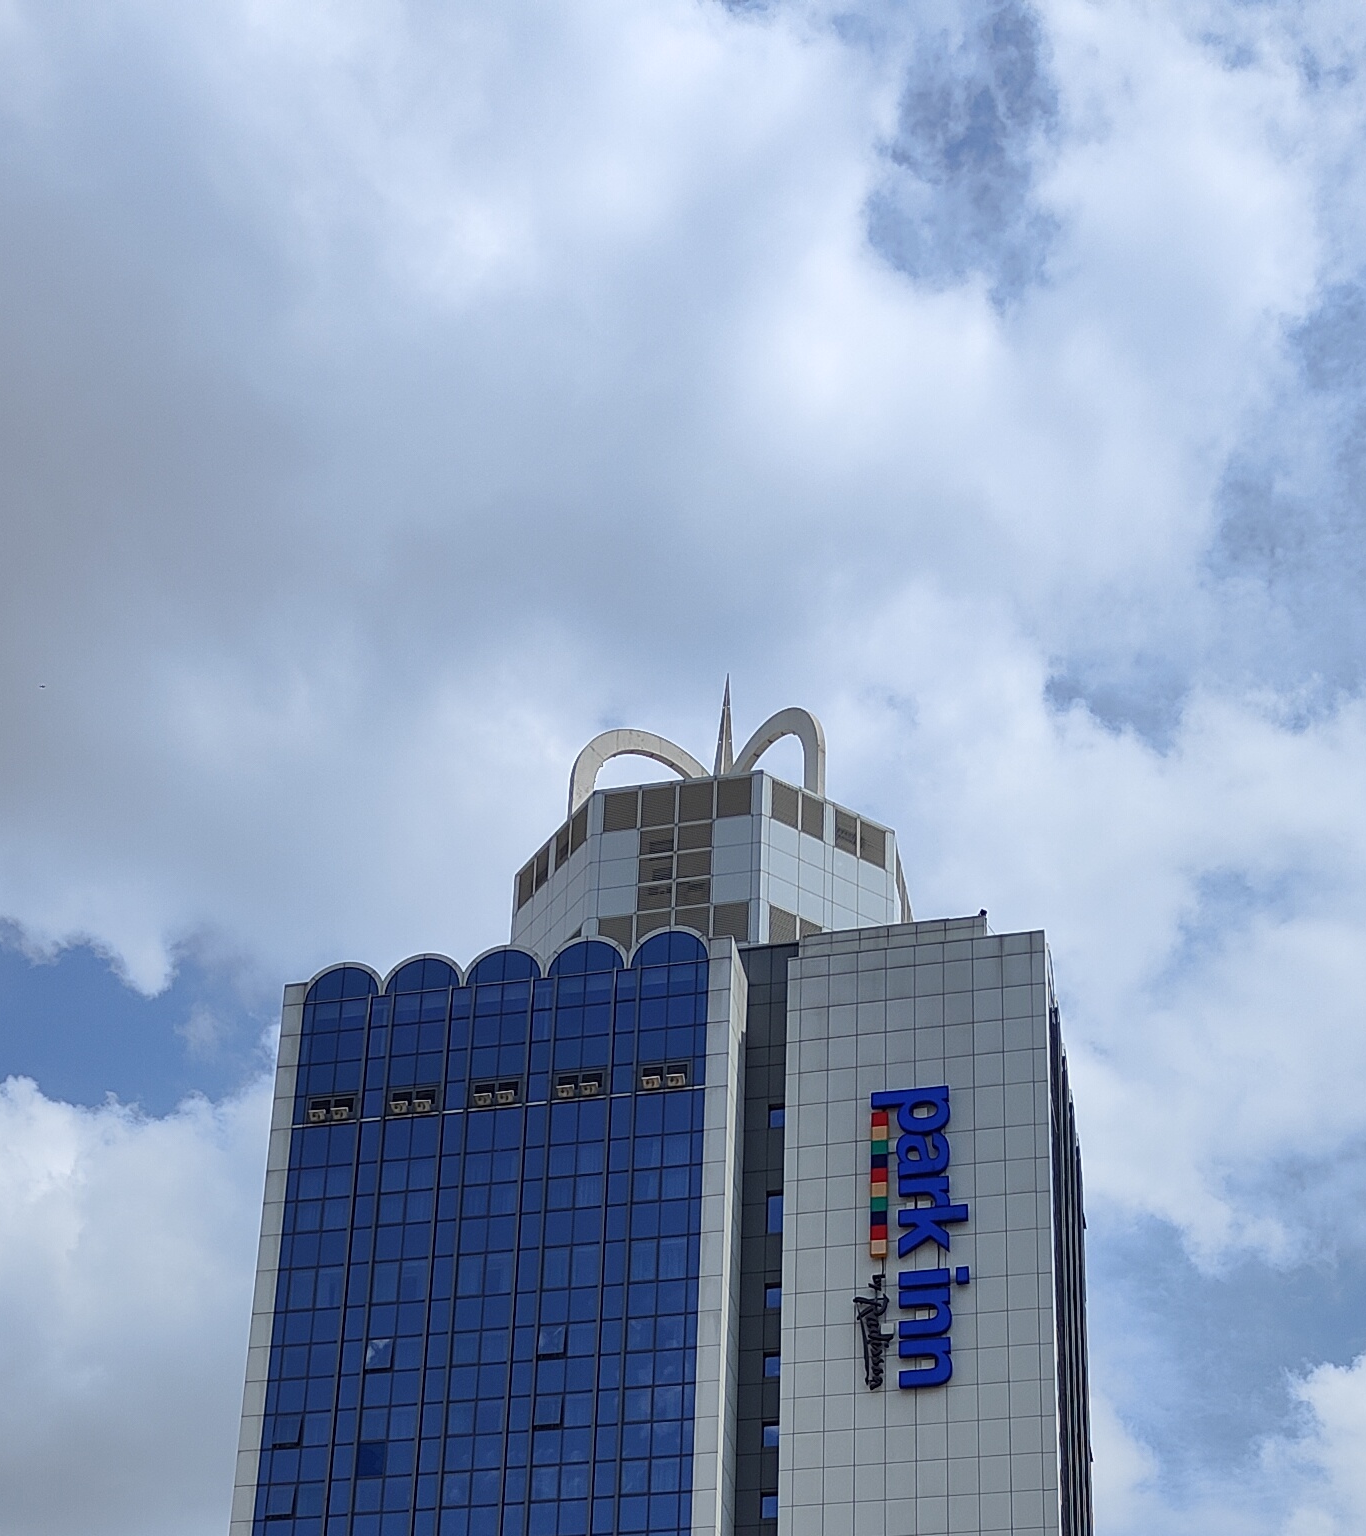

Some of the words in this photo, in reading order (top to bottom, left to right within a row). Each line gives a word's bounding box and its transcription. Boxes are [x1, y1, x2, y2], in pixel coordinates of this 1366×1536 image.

[870, 1084, 969, 1259] park
[867, 1273, 886, 1292] by
[898, 1266, 970, 1390] inn
[852, 1292, 895, 1391] Radisson
